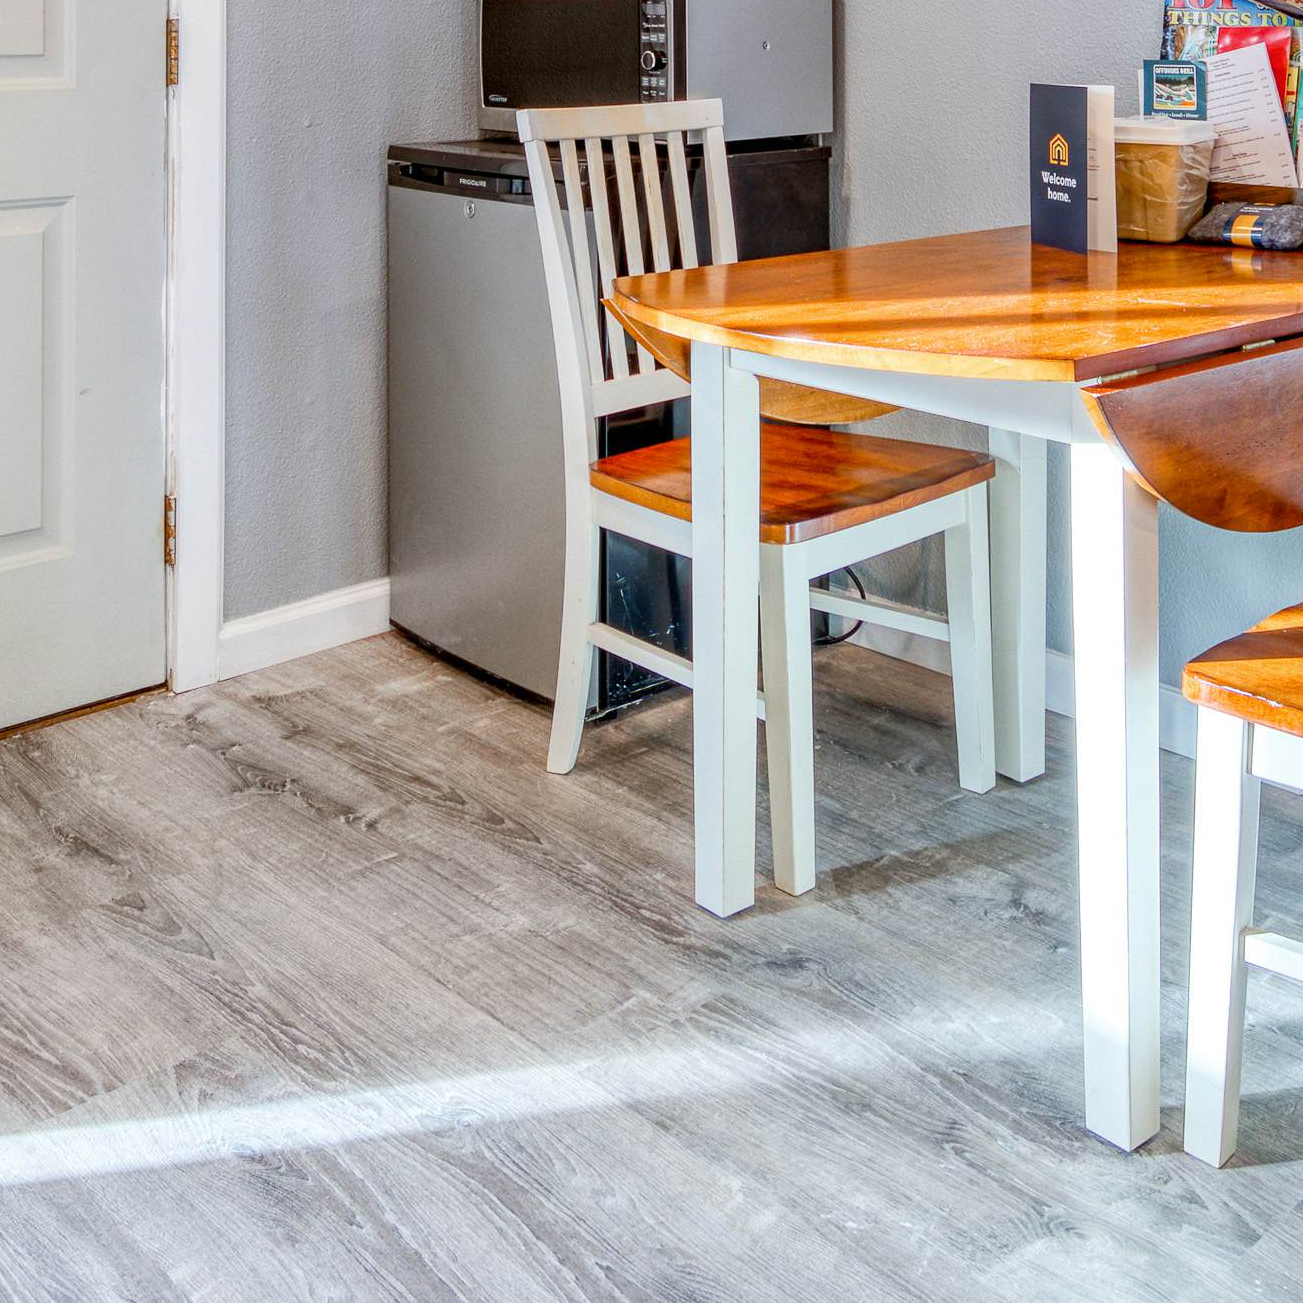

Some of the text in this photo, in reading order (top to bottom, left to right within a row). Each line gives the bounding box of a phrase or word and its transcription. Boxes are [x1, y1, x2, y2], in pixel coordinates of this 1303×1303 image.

[1167, 11, 1251, 26] THINGS
[1257, 13, 1288, 27] TO
[1041, 171, 1077, 188] Welcome
[1047, 187, 1071, 203] home.
